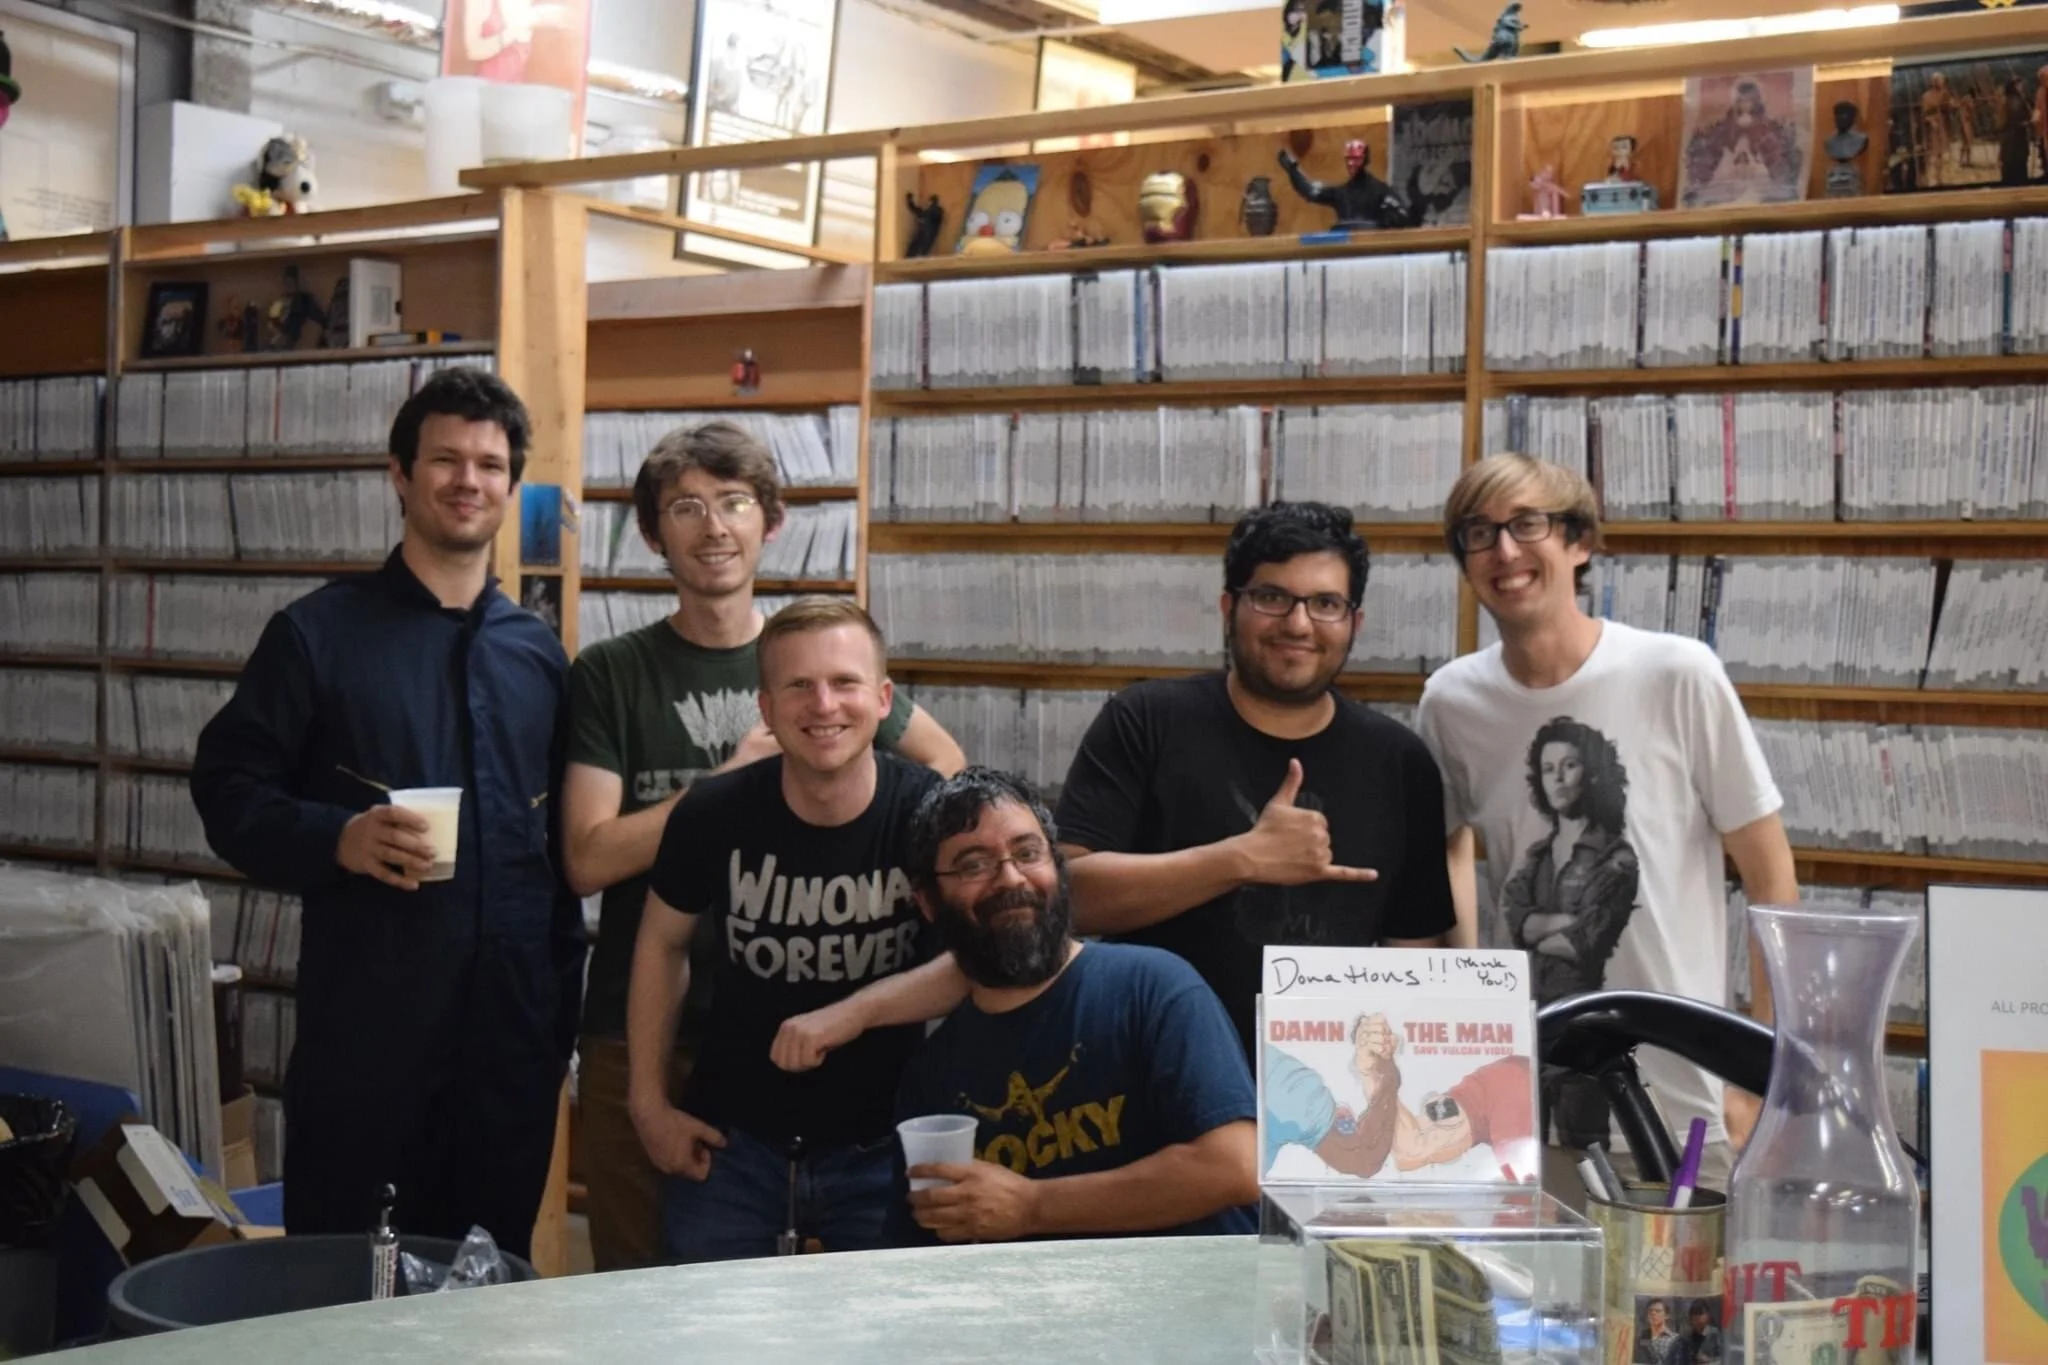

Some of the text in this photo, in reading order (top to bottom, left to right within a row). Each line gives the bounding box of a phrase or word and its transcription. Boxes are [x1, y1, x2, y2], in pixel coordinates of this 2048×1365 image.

[729, 848, 913, 926] WINONA
[726, 914, 920, 983] FOREVER
[1269, 1020, 1513, 1044] DAMN THE MAN
[1991, 1000, 2016, 1014] ALL
[974, 1094, 1126, 1177] OCKY
